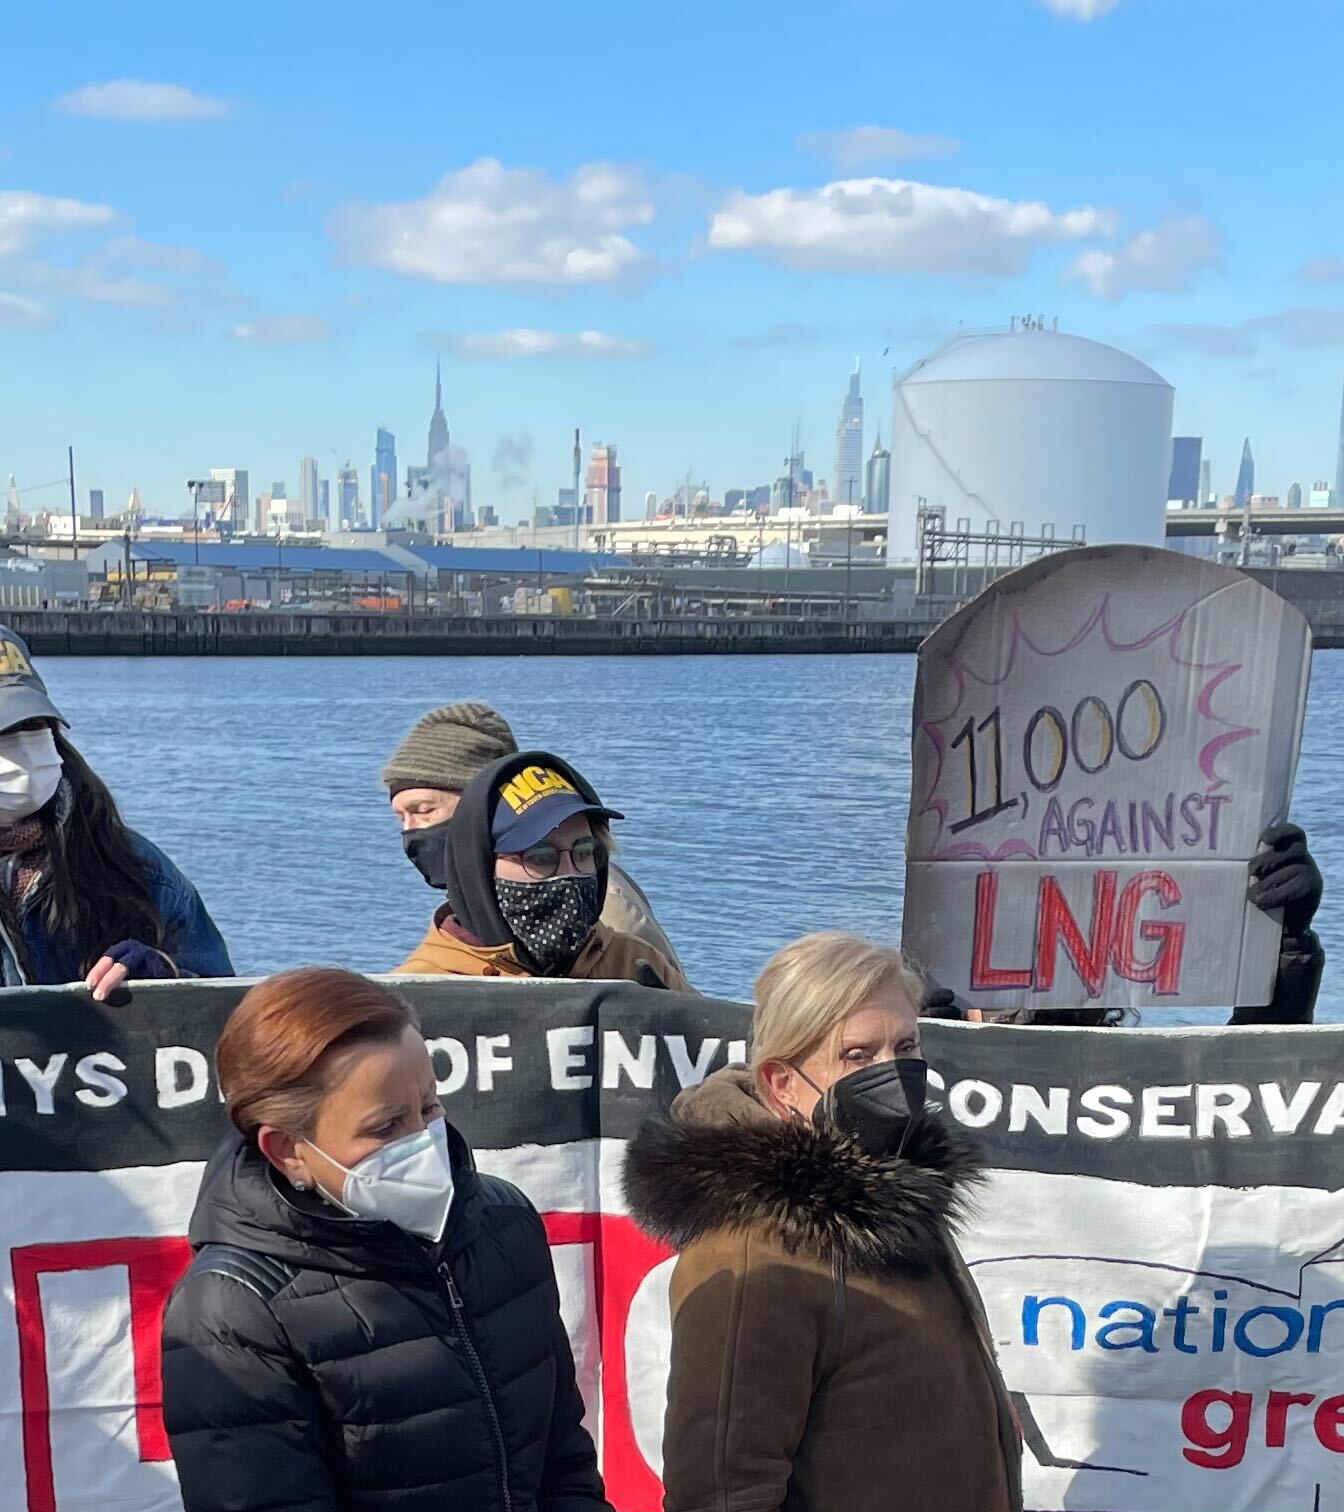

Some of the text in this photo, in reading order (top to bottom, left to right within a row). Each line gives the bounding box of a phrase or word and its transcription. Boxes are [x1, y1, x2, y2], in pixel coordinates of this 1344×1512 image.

[950, 679, 1167, 835] 11,000
[1038, 793, 1233, 857] AGAINST
[969, 869, 1186, 998] LNG
